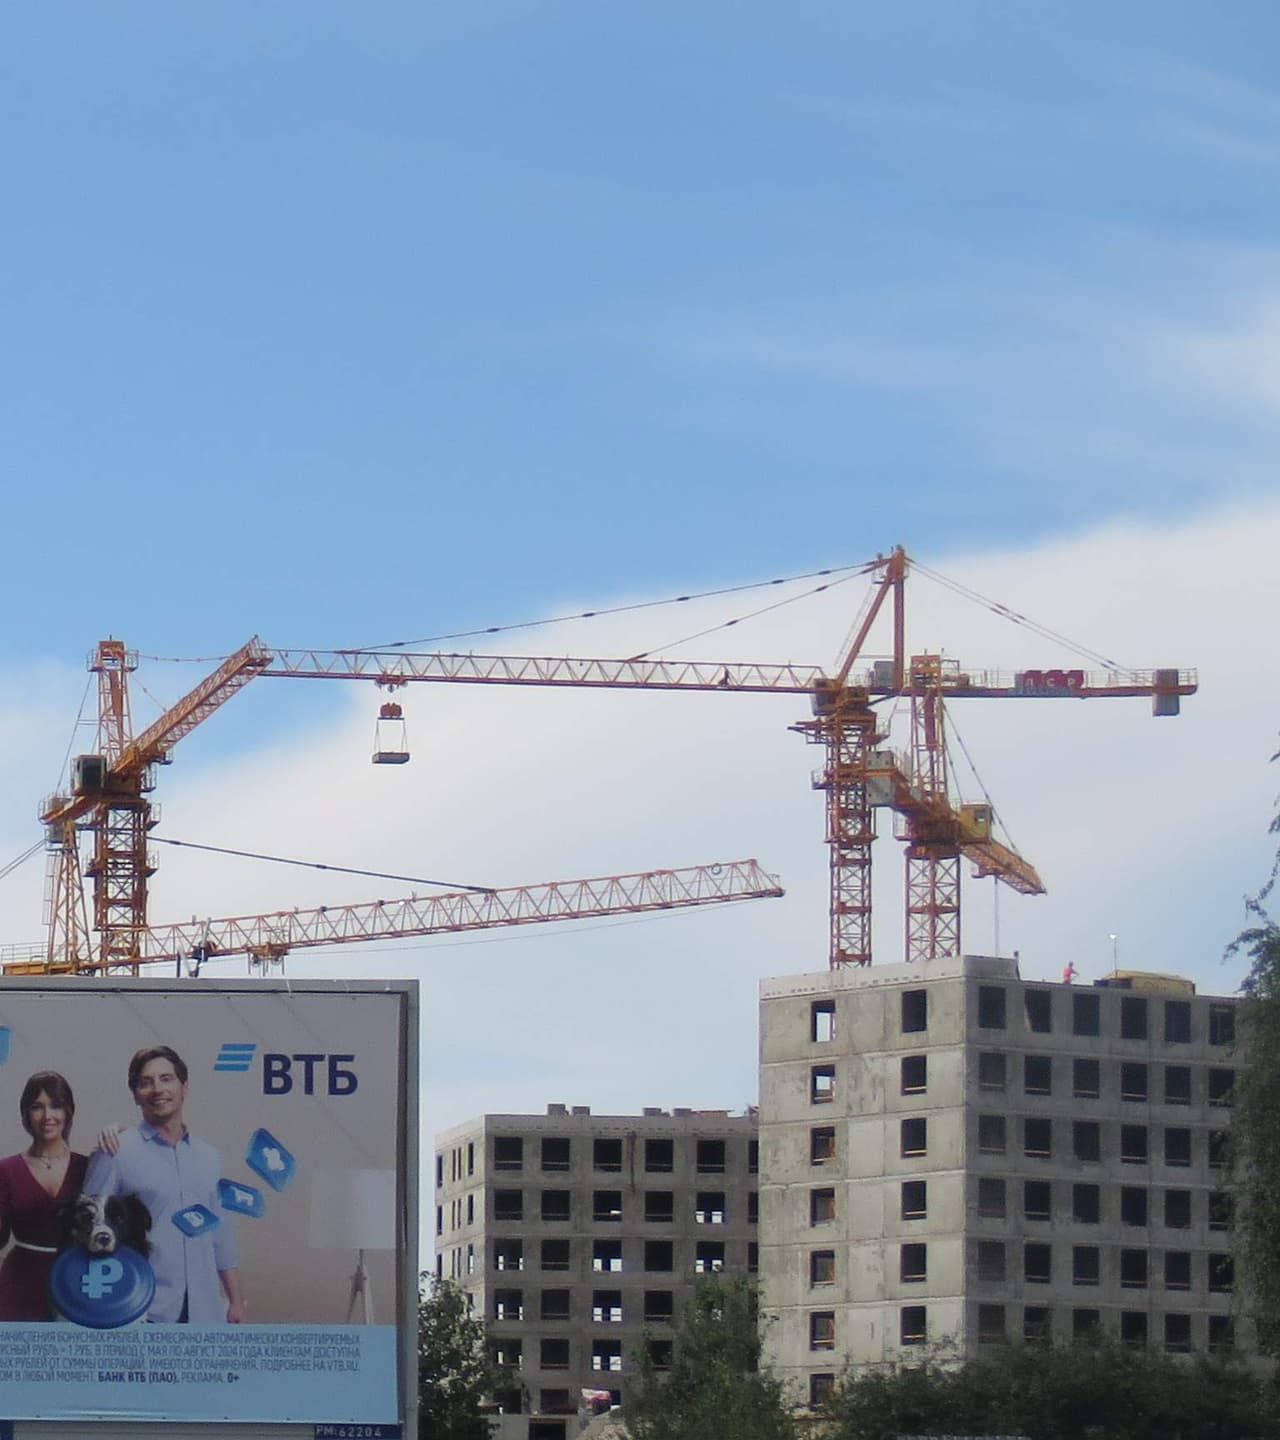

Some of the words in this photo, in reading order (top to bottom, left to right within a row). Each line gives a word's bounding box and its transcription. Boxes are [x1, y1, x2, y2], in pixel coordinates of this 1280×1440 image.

[263, 1054, 358, 1095] ВТБ
[98, 1371, 125, 1383] БАНК
[128, 1372, 146, 1383] ВТБ
